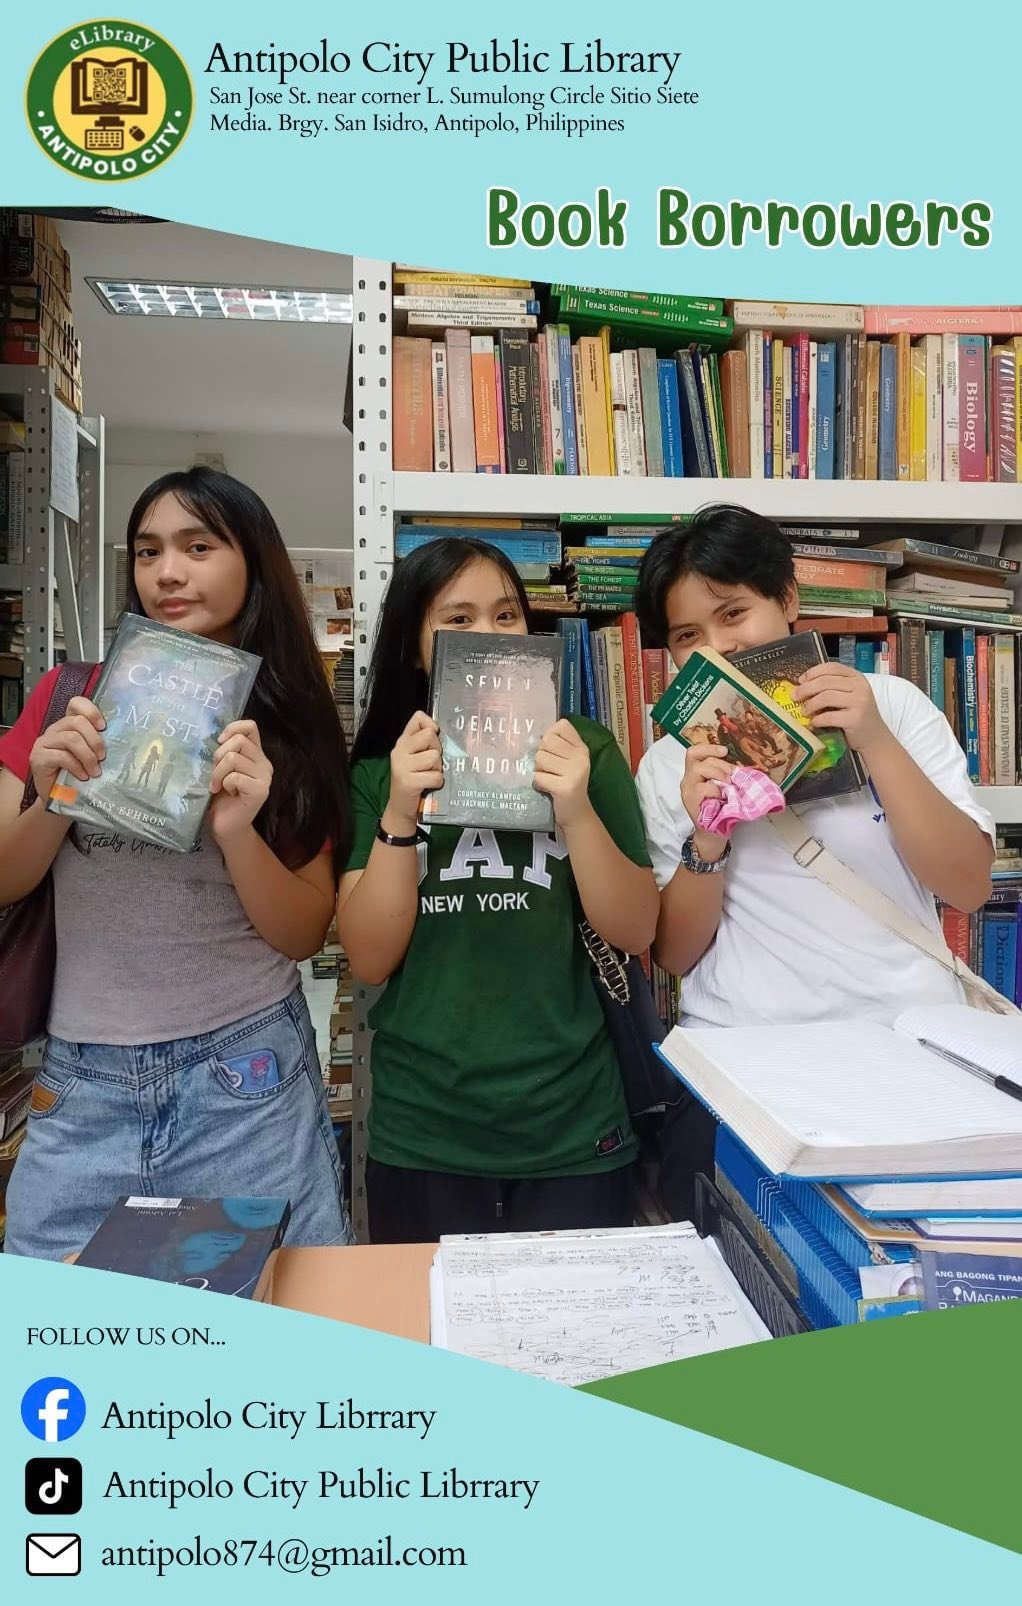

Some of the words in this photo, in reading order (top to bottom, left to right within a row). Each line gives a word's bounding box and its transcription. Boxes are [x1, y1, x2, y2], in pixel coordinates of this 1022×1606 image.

[584, 299, 607, 311] Texas
[608, 302, 640, 315] Science
[598, 287, 629, 299] Science
[774, 376, 782, 415] SCIENCE
[884, 377, 892, 412] Geometry
[821, 415, 830, 451] Geometry
[963, 381, 978, 453] Biology
[797, 565, 845, 575] TEBRATE
[628, 633, 636, 649] THE
[753, 649, 785, 663] BEASLEY
[911, 626, 920, 681] Biochemi
[465, 673, 532, 692] SEVEN
[613, 663, 622, 699] Organic
[629, 650, 638, 683] SCIENCE
[965, 655, 976, 708] Biochemistry
[128, 664, 224, 711] CASTLE
[631, 684, 640, 716] LIBRARY
[673, 716, 684, 728] by
[679, 696, 700, 719] Charles
[694, 674, 715, 699] Dickens
[675, 693, 693, 712] Oliver
[687, 680, 701, 696] Twist
[125, 704, 199, 743] MST
[455, 713, 536, 736] DEADLY
[615, 700, 625, 746] Chemistry
[443, 757, 533, 776] SHADOW
[457, 789, 490, 799] COURTNEY
[88, 797, 116, 812] AMY
[118, 804, 166, 828] EPHRON
[83, 831, 126, 854] Totally
[415, 824, 570, 891] AP
[421, 894, 465, 915] NEW
[476, 892, 531, 912] YORK
[995, 925, 1009, 991] Diction
[935, 1270, 954, 1278] ANG
[956, 1271, 996, 1281] BAGONG
[998, 1274, 1022, 1283] TIPAN
[962, 1290, 1017, 1304] MAGAN
